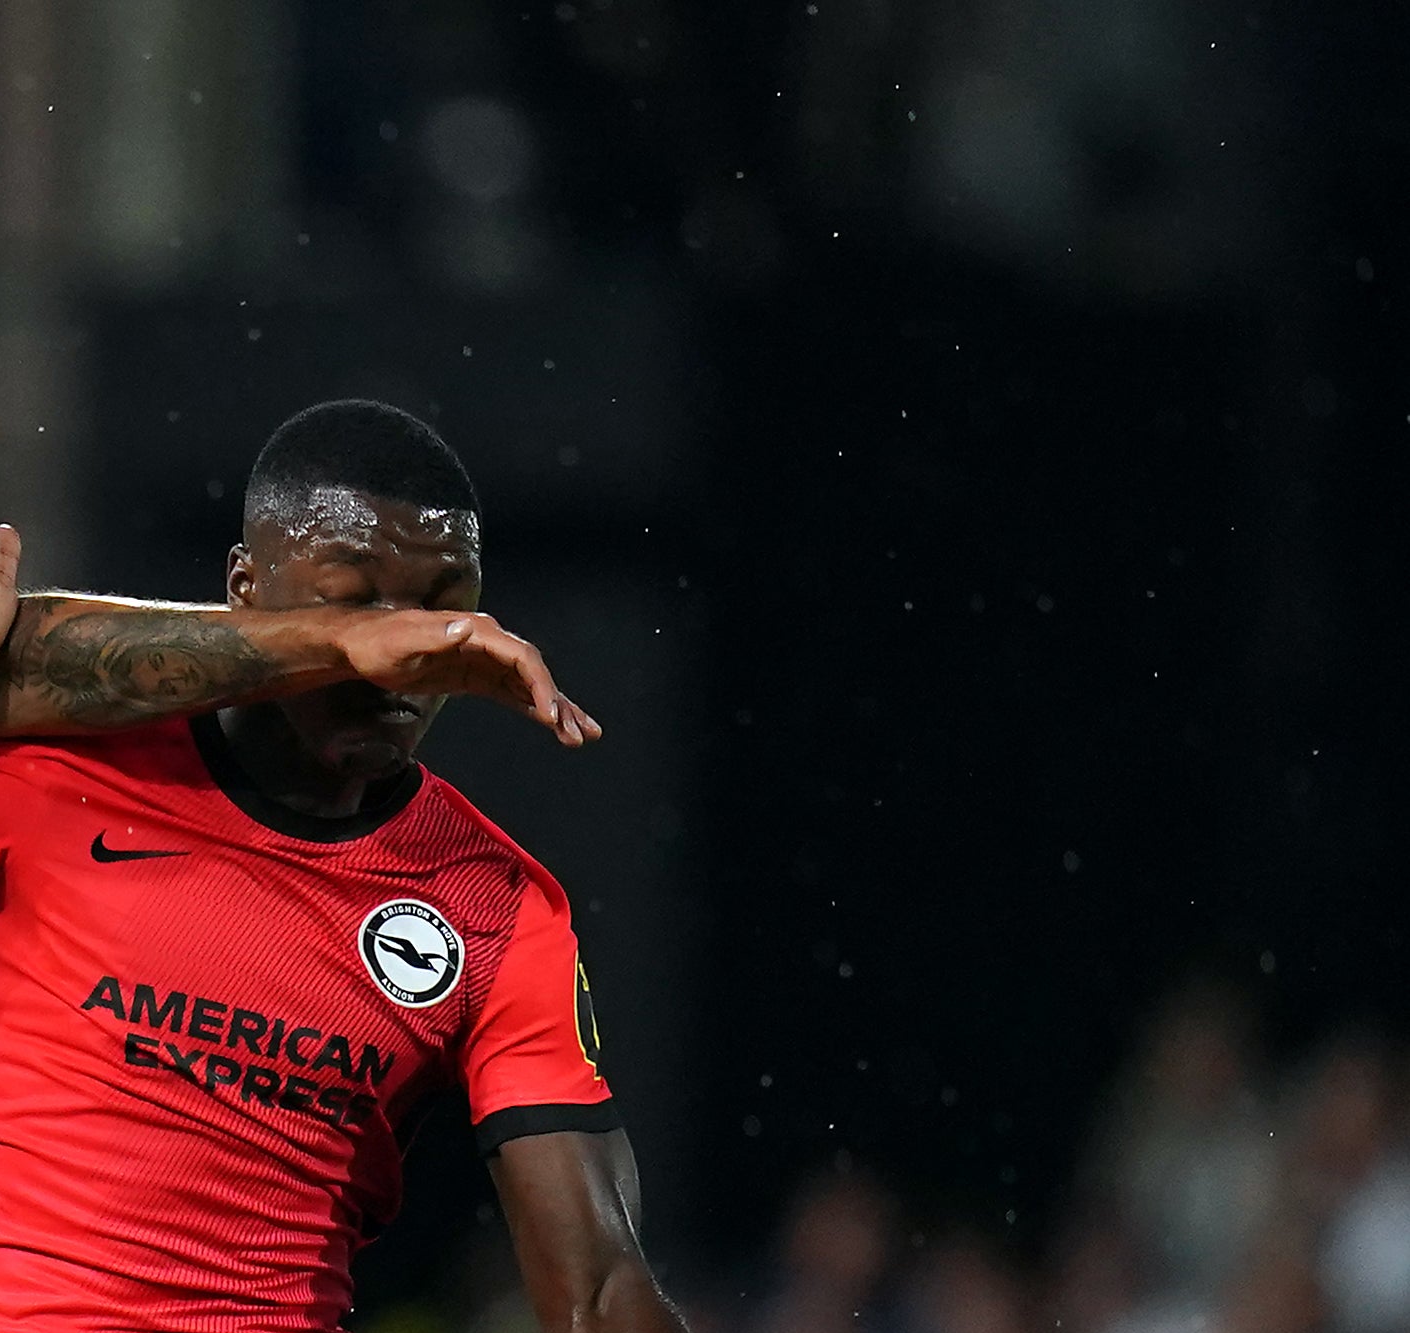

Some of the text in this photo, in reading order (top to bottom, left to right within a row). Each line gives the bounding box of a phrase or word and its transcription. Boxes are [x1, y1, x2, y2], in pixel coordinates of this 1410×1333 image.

[380, 905, 431, 920] BRIGHTON
[440, 925, 458, 952] HOVE
[381, 977, 415, 1003] ALBION
[81, 975, 395, 1087] AMERICAN
